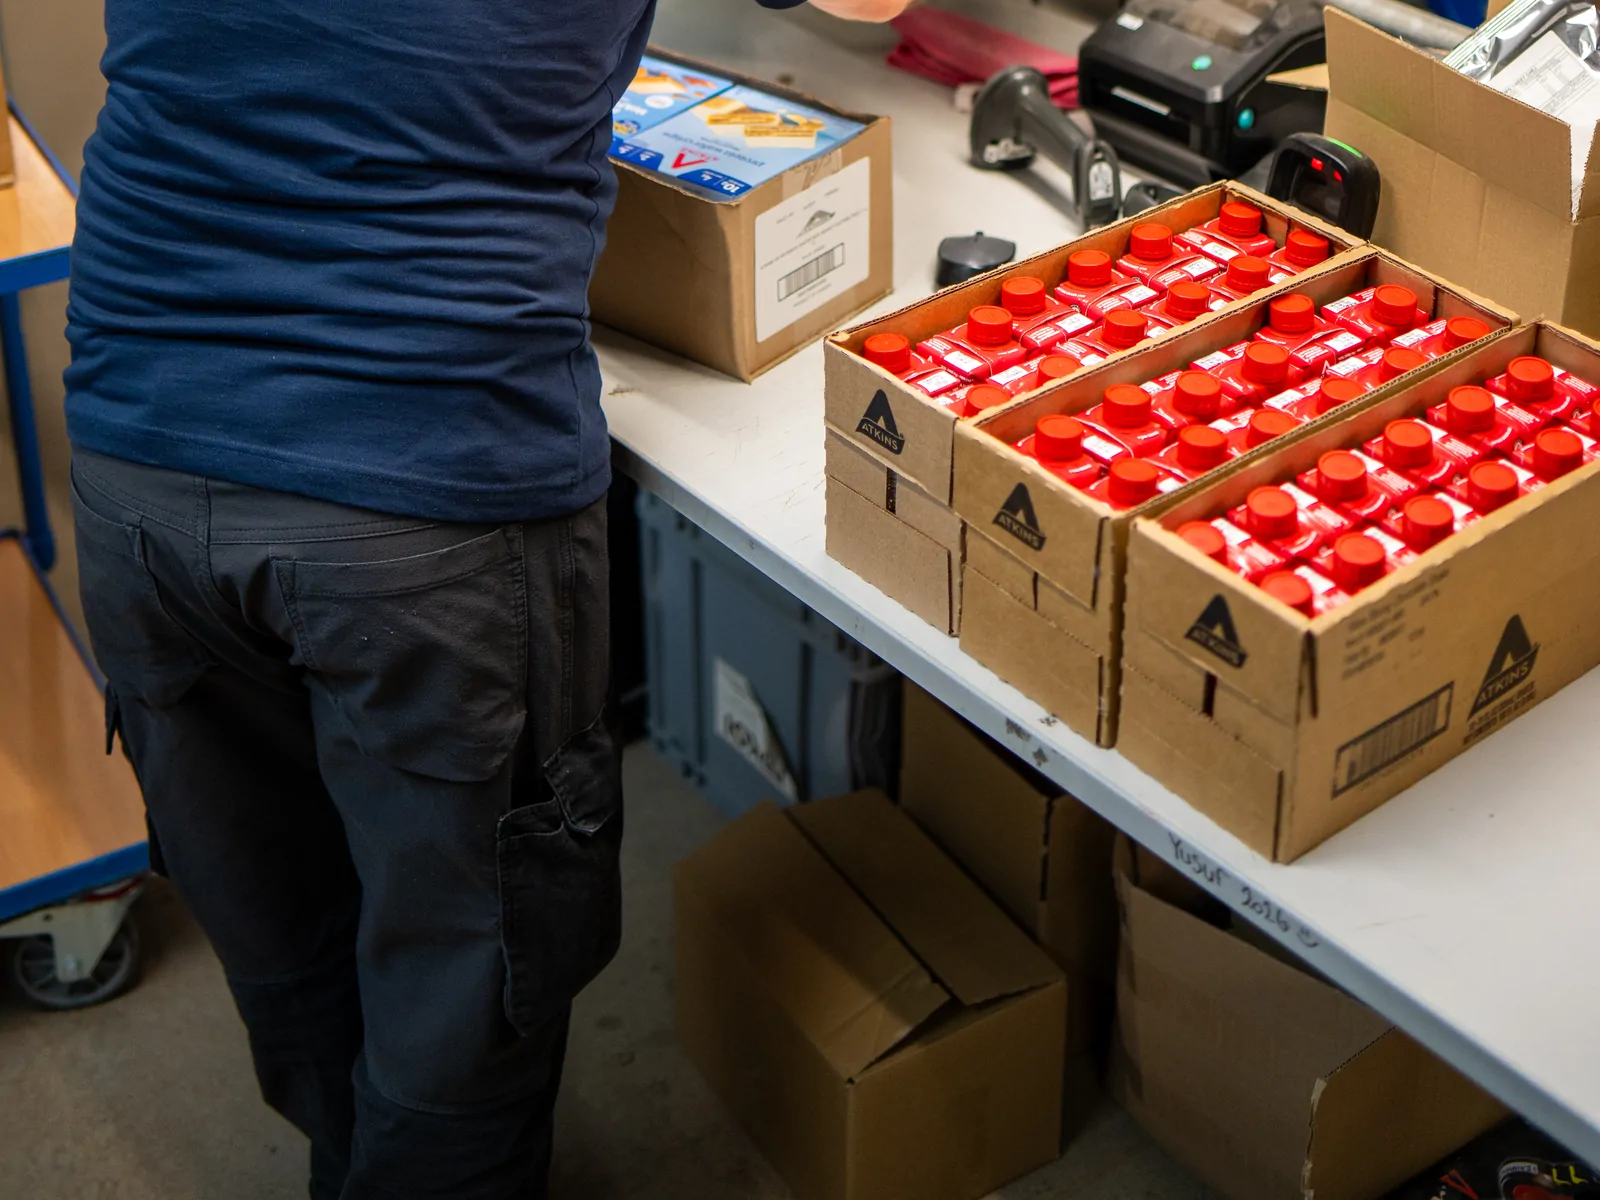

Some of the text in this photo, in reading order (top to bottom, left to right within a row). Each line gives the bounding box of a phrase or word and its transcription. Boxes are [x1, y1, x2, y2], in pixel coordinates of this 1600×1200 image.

[861, 422, 898, 451] ATKINS
[998, 513, 1039, 548] ATKINS
[1477, 660, 1530, 706] ATKINS
